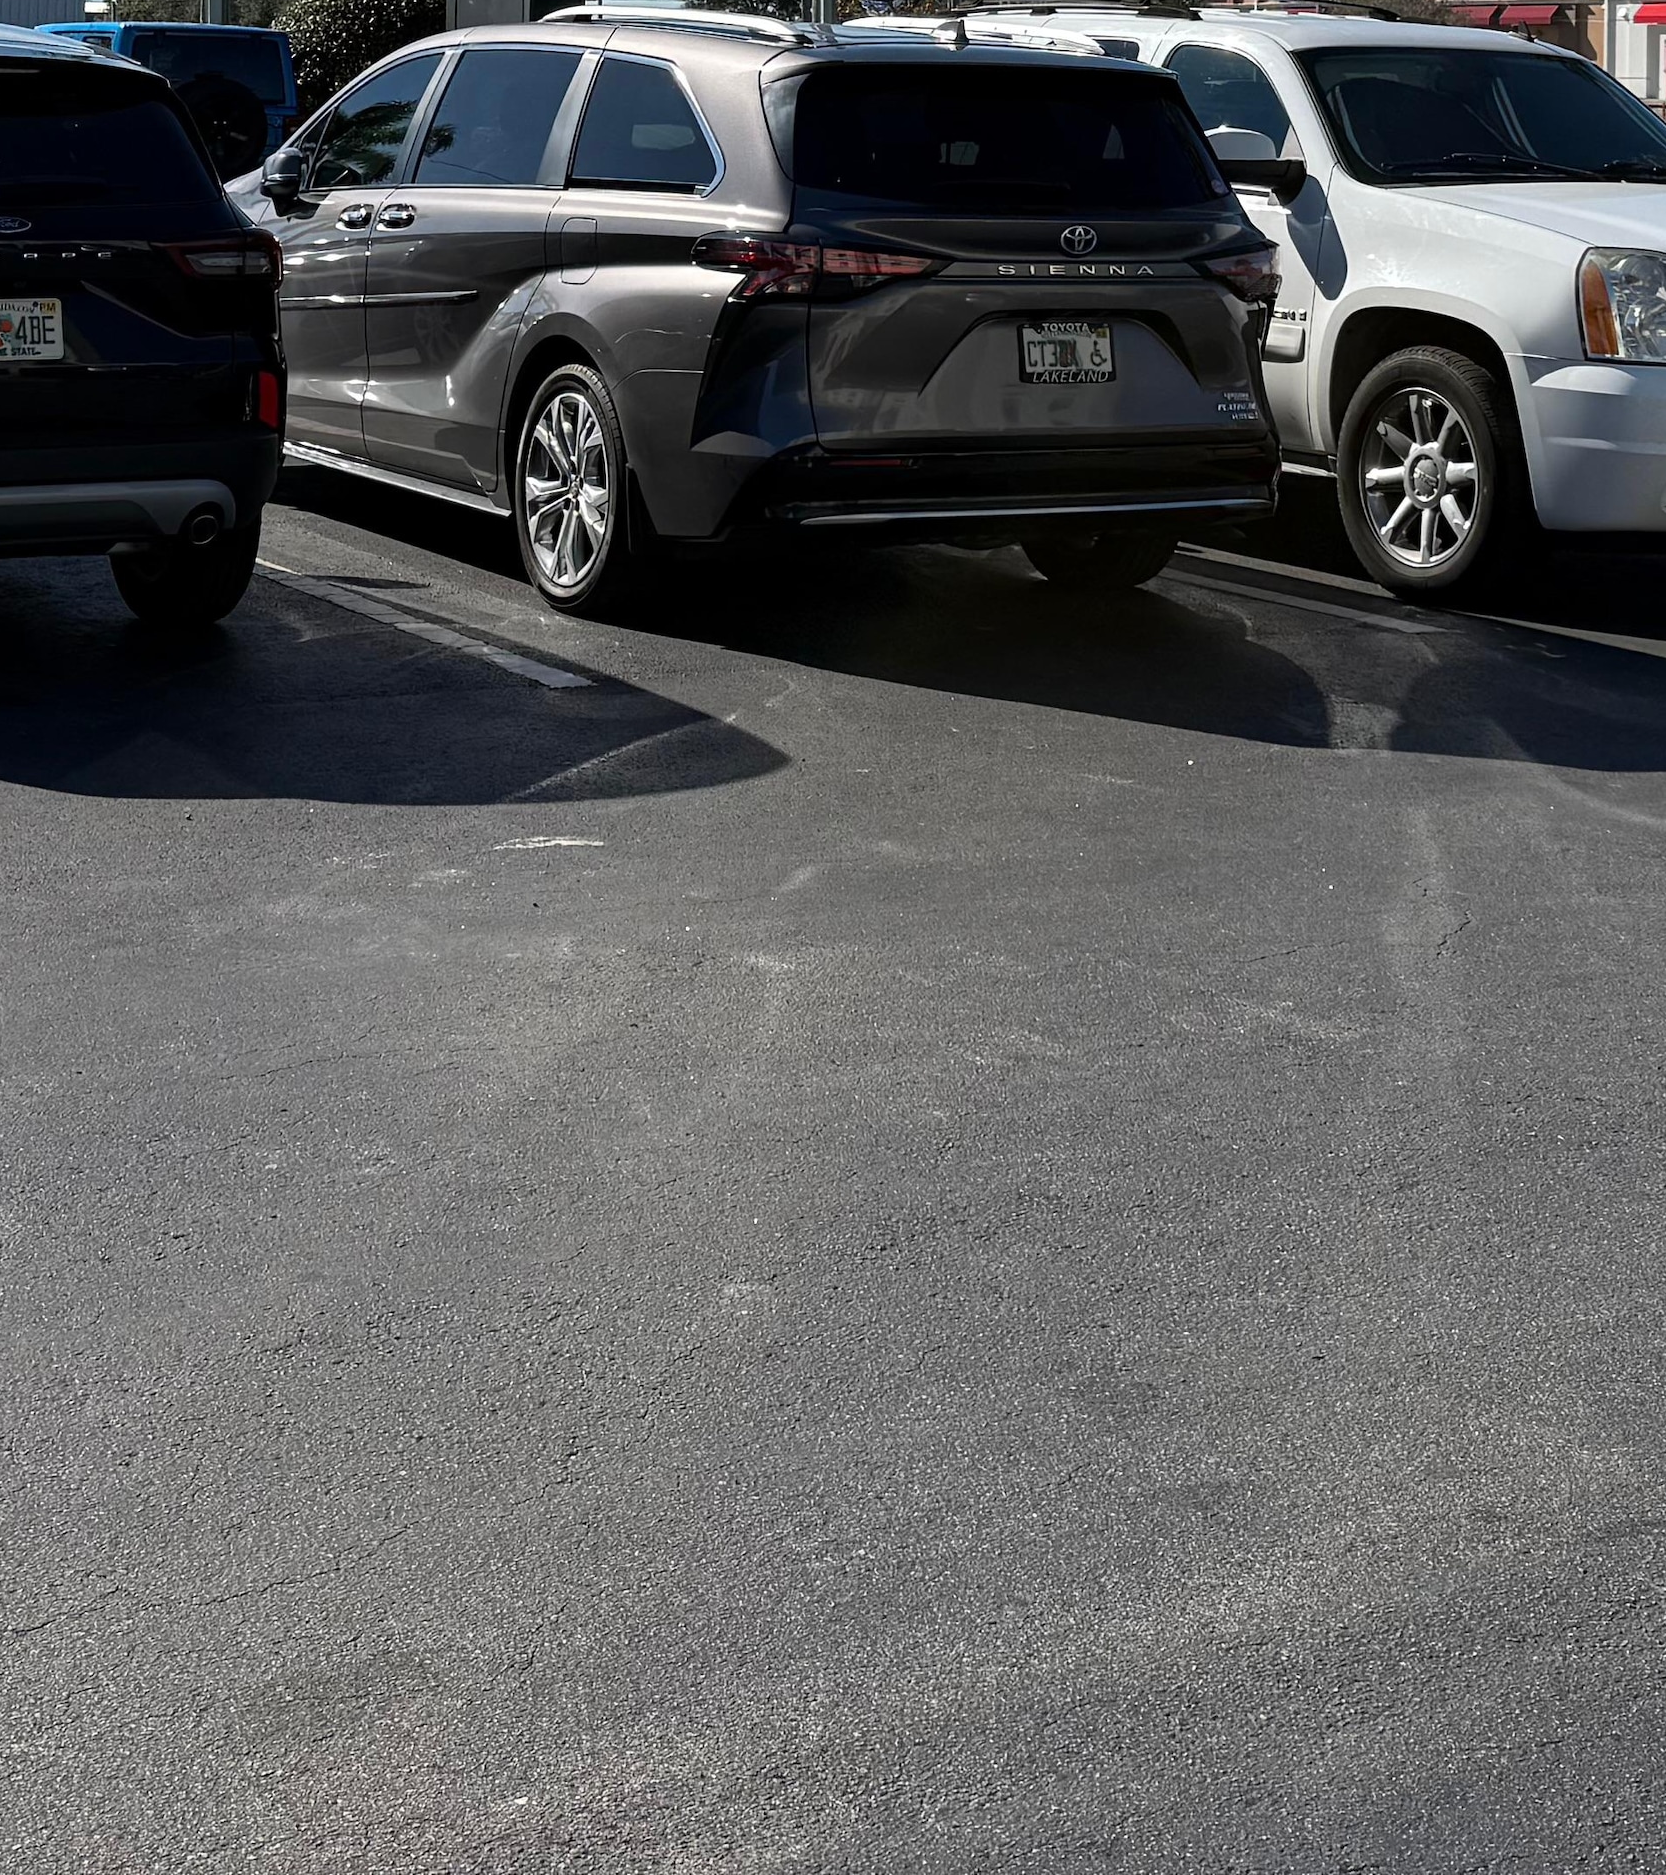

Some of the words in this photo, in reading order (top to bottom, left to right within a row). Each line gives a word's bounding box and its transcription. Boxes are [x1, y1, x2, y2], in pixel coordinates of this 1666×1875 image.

[998, 265, 1154, 275] SIENNA
[1041, 323, 1089, 332] TOYOTA
[1032, 370, 1109, 383] LAKELAND
